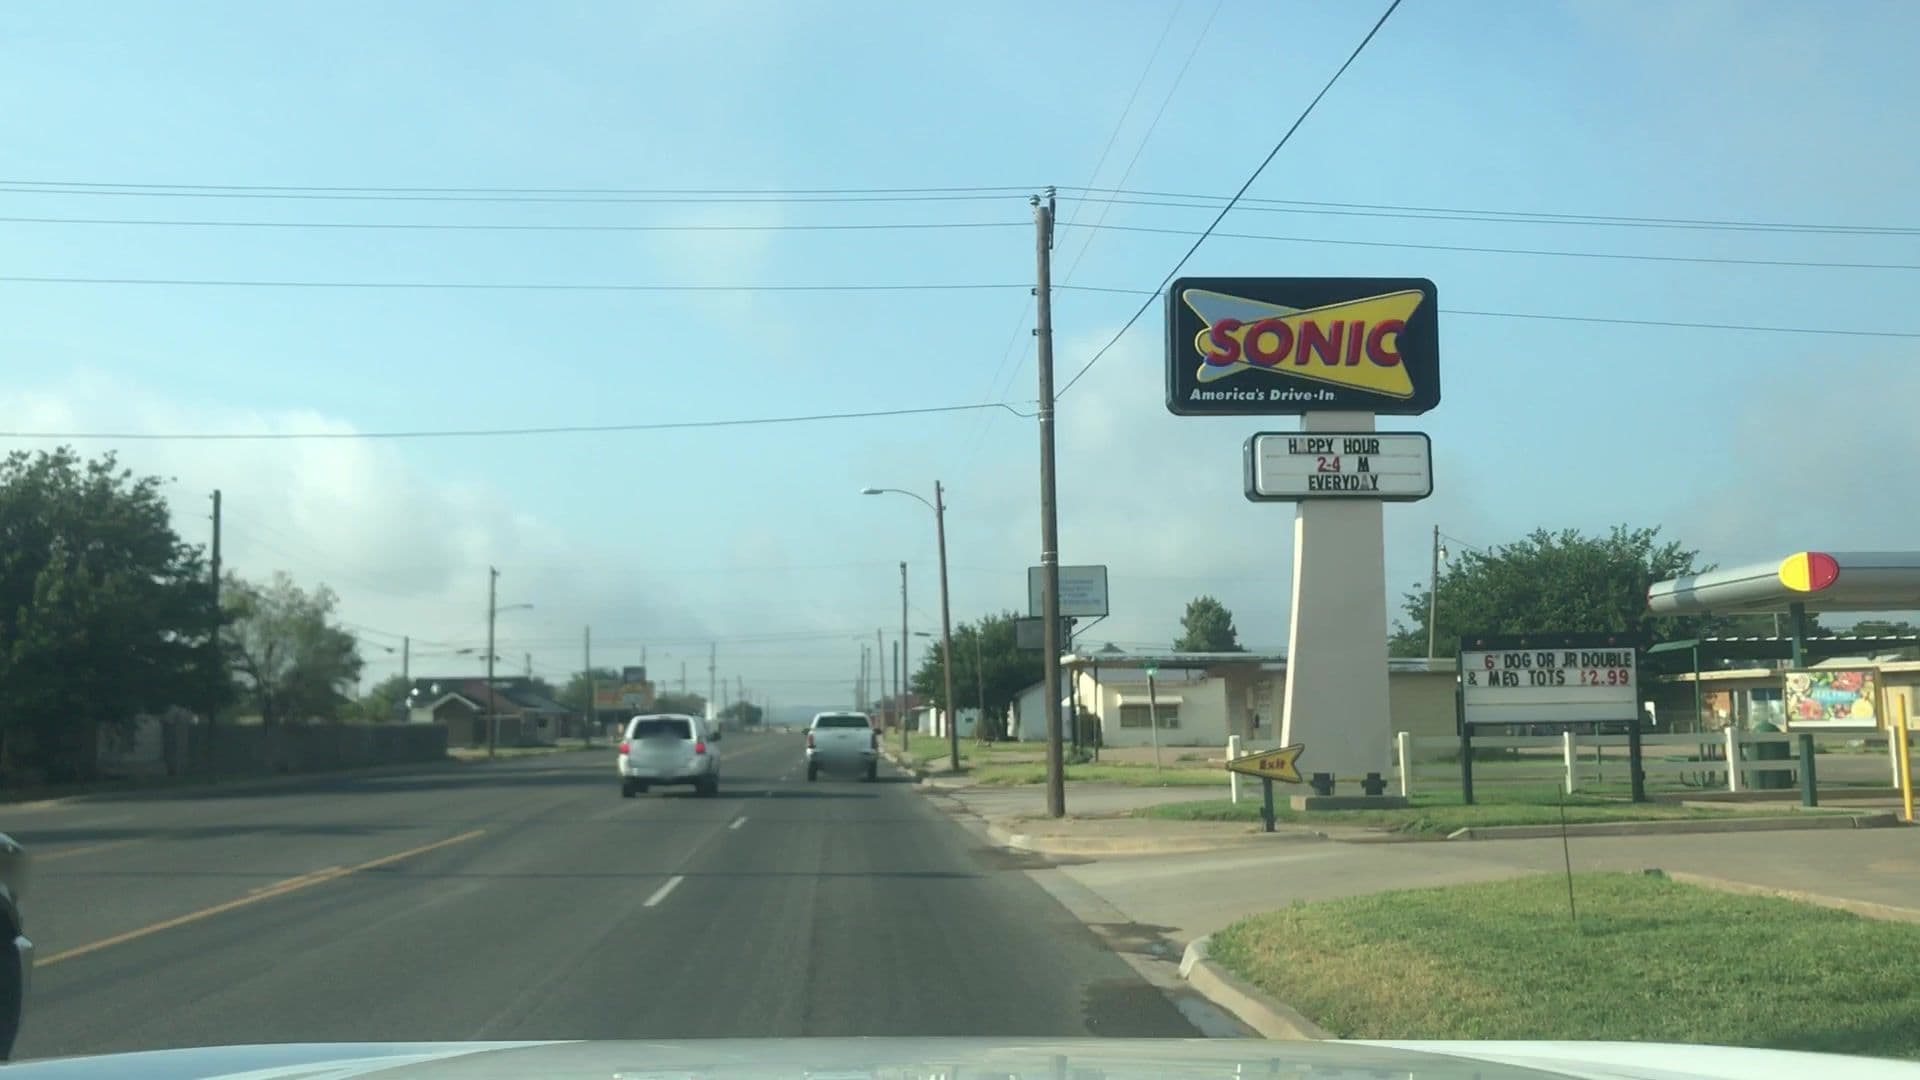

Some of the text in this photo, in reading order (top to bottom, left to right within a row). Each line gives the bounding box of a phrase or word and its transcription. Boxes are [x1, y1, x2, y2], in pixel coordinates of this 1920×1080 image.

[1204, 318, 1406, 367] SONIC
[1190, 387, 1265, 400] America's
[1288, 438, 1380, 454] HPPY HOUR
[1317, 456, 1340, 472] 2-4
[1308, 474, 1379, 491] EVERYDAY
[1504, 652, 1531, 669] DOG
[1536, 652, 1555, 668] OR
[1562, 651, 1578, 668] JR
[1581, 651, 1633, 668] DOUBLE
[1468, 668, 1630, 687] & MED TOTS $2.99
[1259, 758, 1286, 770] Exit
